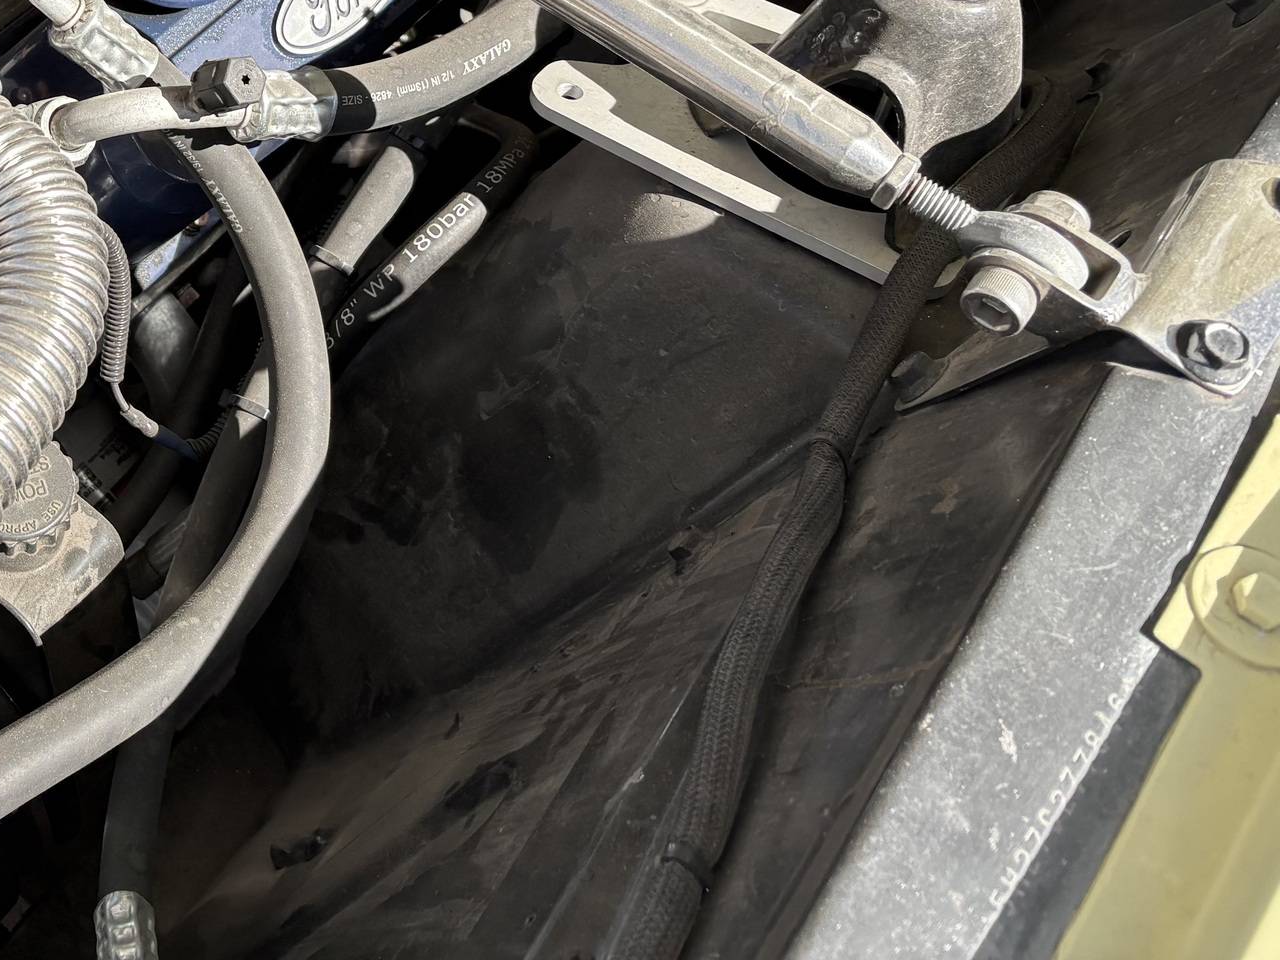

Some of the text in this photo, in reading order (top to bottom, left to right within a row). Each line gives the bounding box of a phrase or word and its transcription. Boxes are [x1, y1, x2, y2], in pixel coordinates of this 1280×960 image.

[463, 39, 512, 76] GALAXY
[431, 75, 442, 87] IN
[441, 69, 456, 83] 1/2
[397, 77, 431, 98] (13mm)
[342, 95, 364, 106] SIZE
[174, 140, 243, 233] GALAXY 13/32 IN
[363, 262, 397, 300] WP
[402, 193, 476, 264] 180bar
[476, 147, 527, 194] 18MPa
[41, 499, 62, 522] USE
